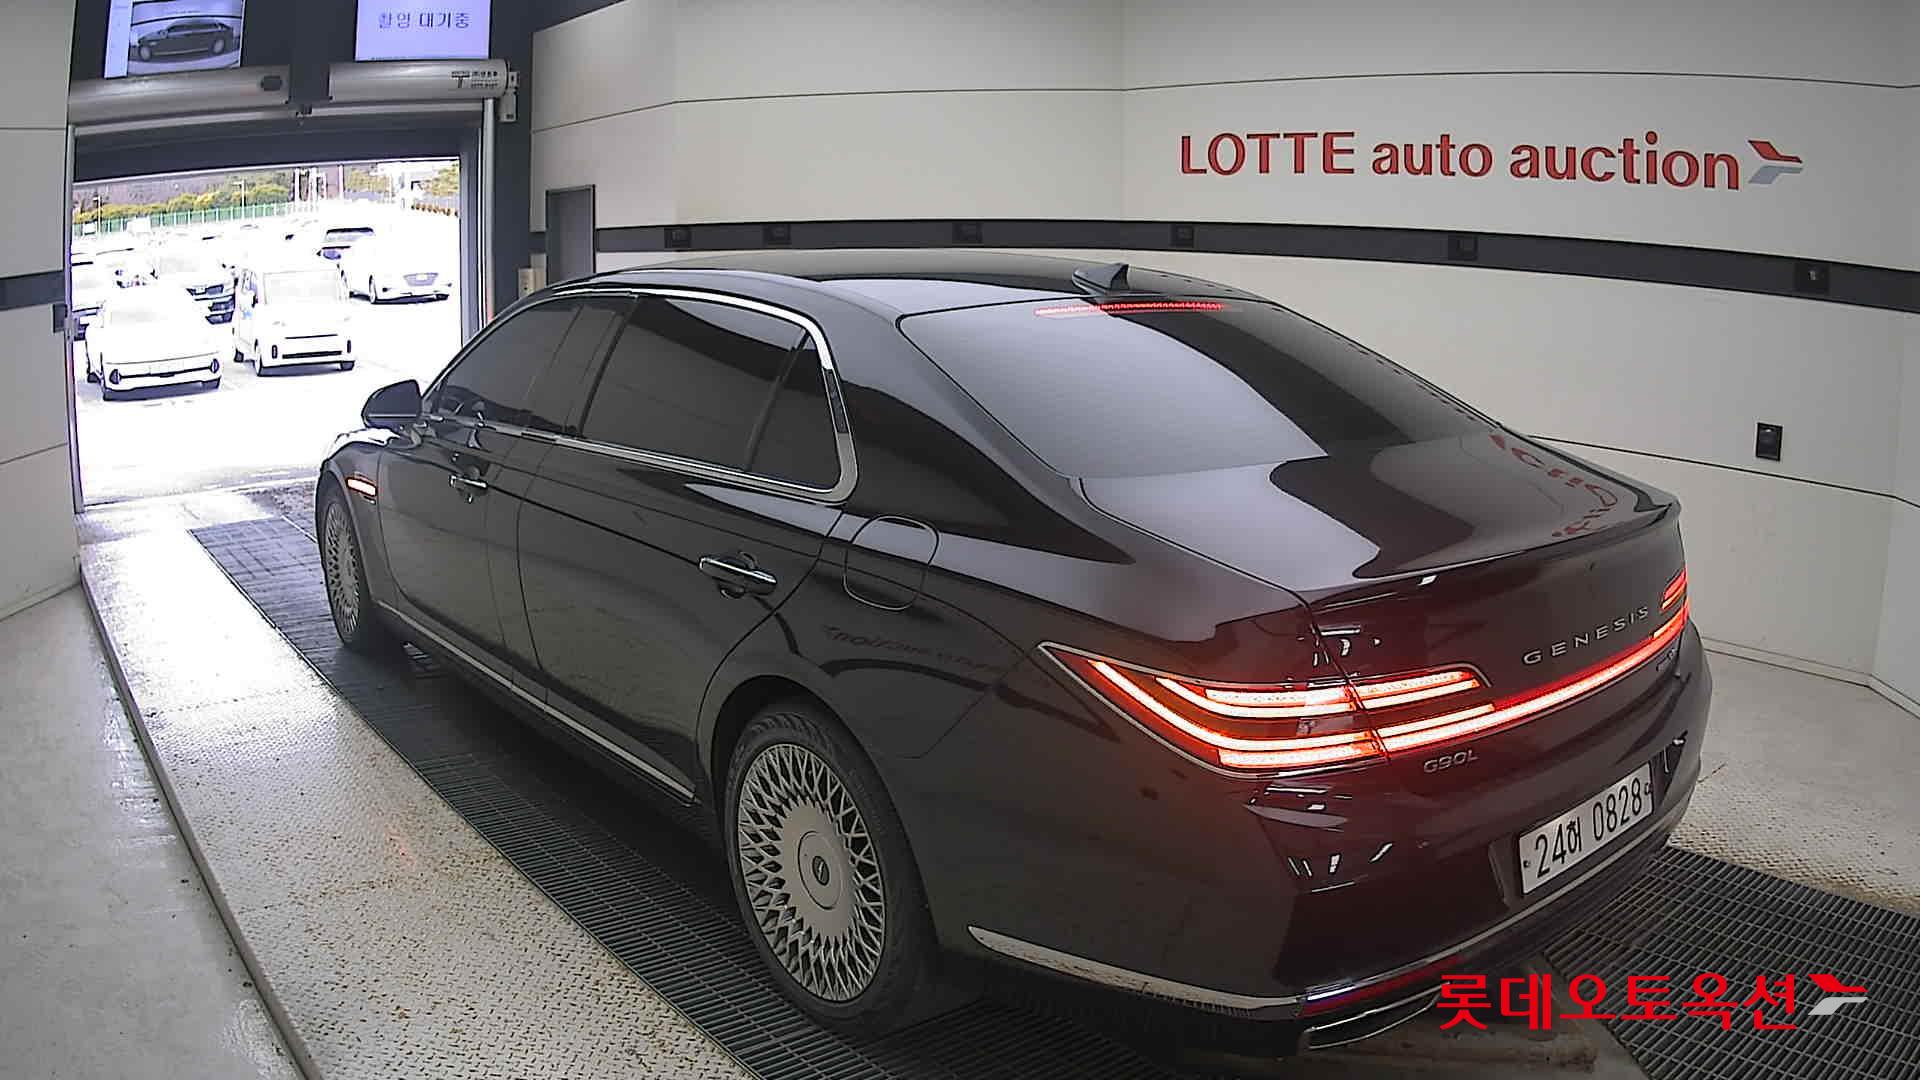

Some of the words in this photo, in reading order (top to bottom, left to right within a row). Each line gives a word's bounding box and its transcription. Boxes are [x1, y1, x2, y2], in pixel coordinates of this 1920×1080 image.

[419, 11, 470, 29] 대기중
[1181, 131, 1356, 174] LOTTE
[1372, 133, 1494, 177] auto
[1510, 131, 1741, 190] auction
[1523, 606, 1649, 665] GENESIS
[1424, 749, 1479, 773] G90L
[1592, 777, 1642, 841] 0828
